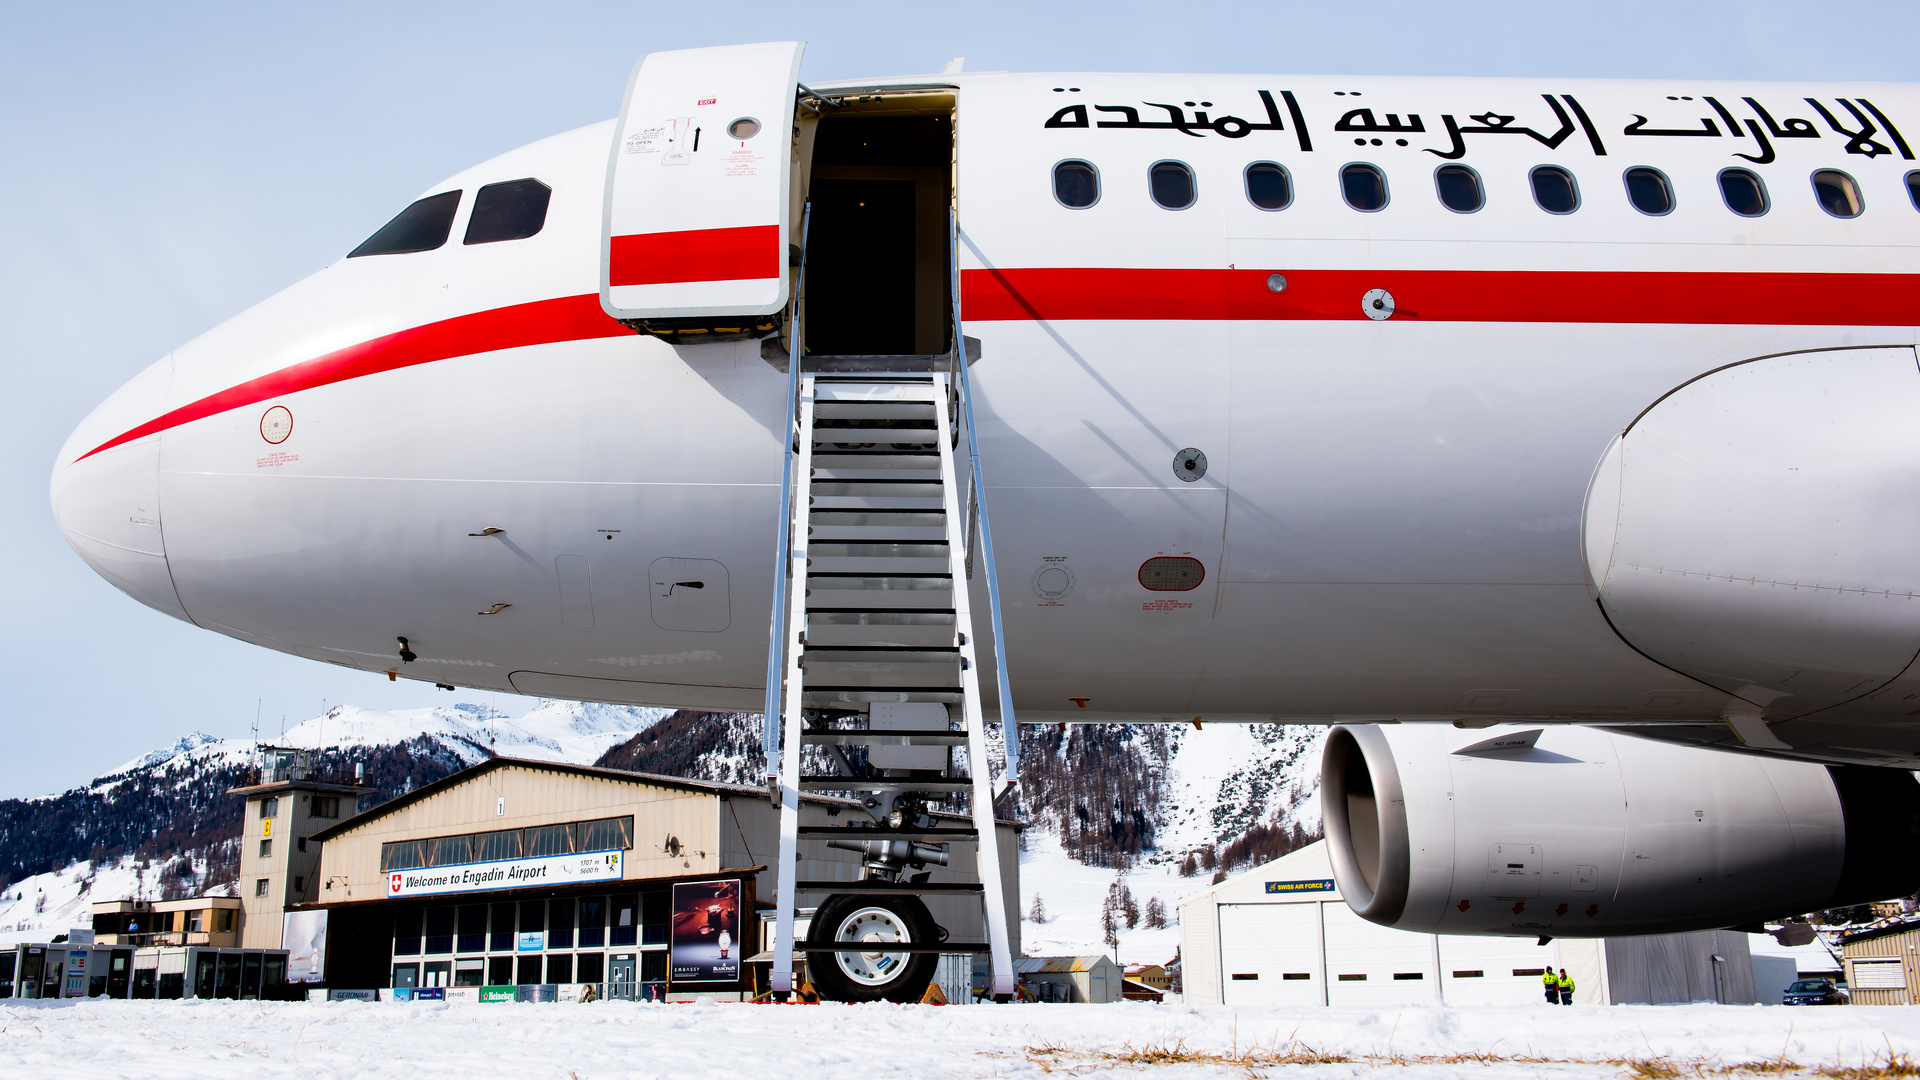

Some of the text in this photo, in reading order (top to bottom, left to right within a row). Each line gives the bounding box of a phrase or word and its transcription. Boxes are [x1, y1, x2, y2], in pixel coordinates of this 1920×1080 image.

[1044, 87, 1314, 152] المتحدة
[1333, 91, 1608, 160] العربية
[405, 864, 547, 888] Welcome to Engadin Airport
[580, 867, 594, 875] 5600
[488, 992, 514, 1000] Heineken
